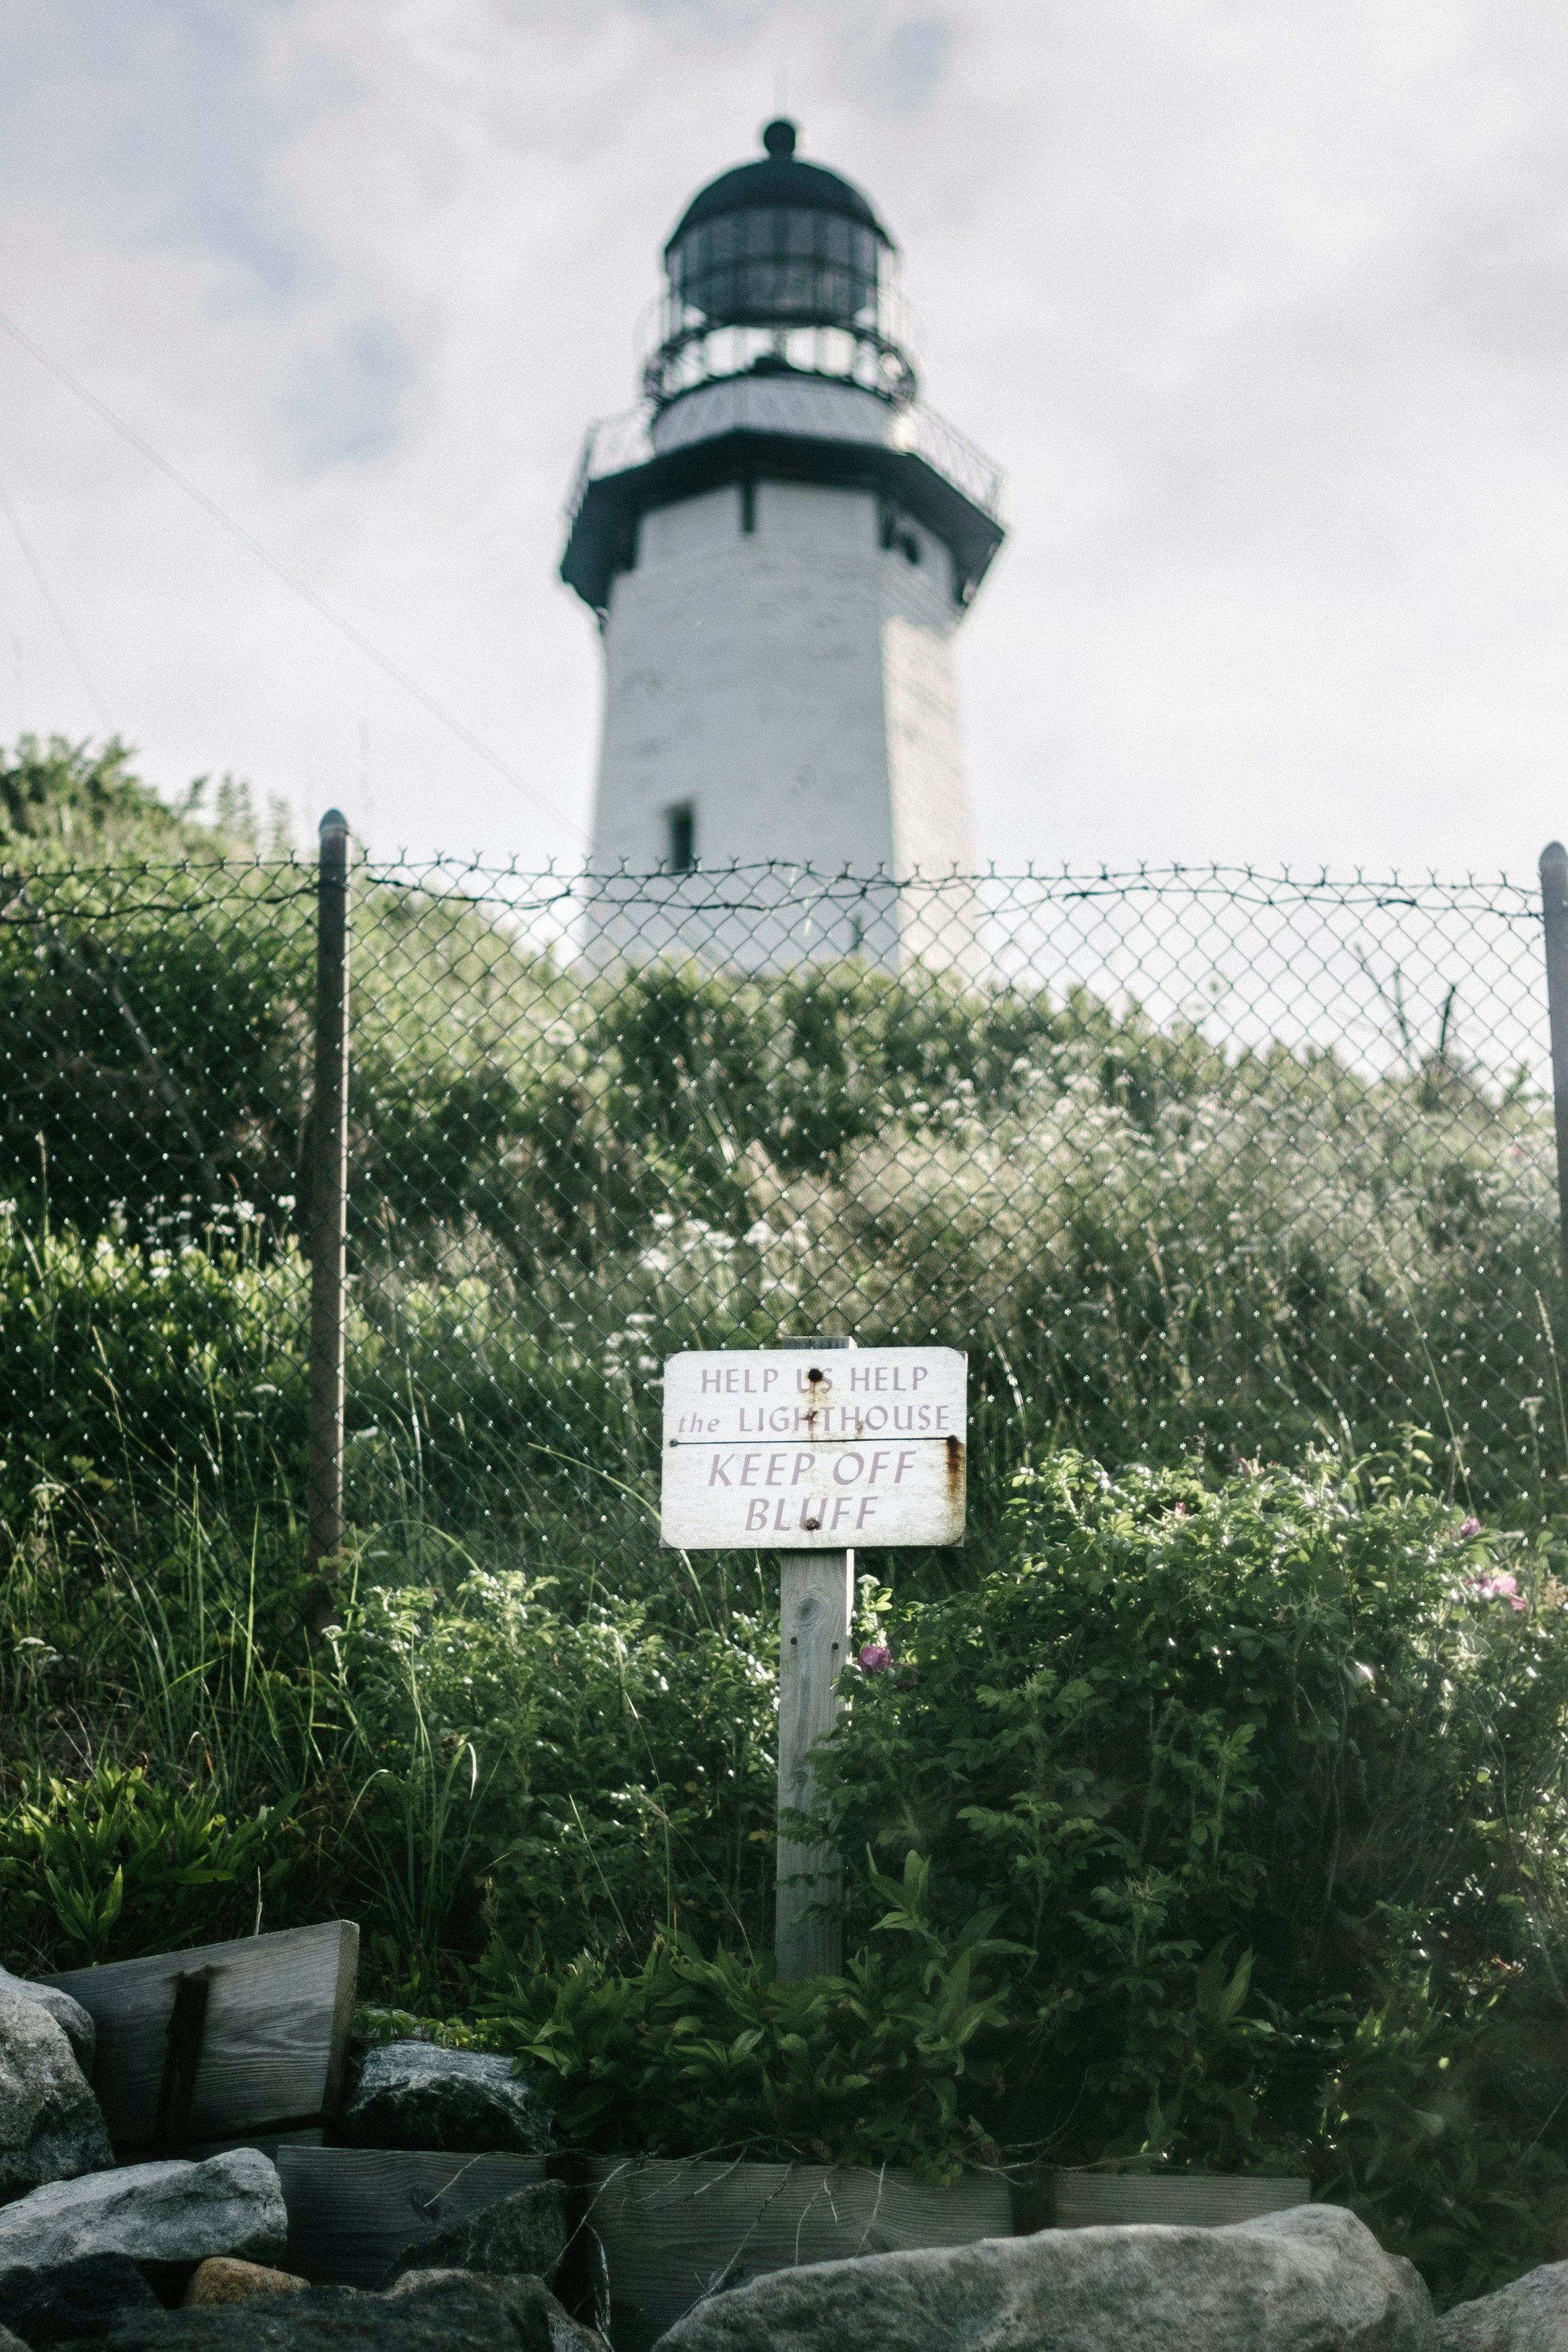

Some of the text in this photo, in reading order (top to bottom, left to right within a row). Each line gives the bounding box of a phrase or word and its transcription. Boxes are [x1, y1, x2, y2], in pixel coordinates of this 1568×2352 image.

[702, 1366, 928, 1394] HELP US HELP
[678, 1405, 949, 1433] the LIGHTHOUSE
[708, 1450, 916, 1486] KEEP OFF
[745, 1495, 878, 1531] BLUFF
